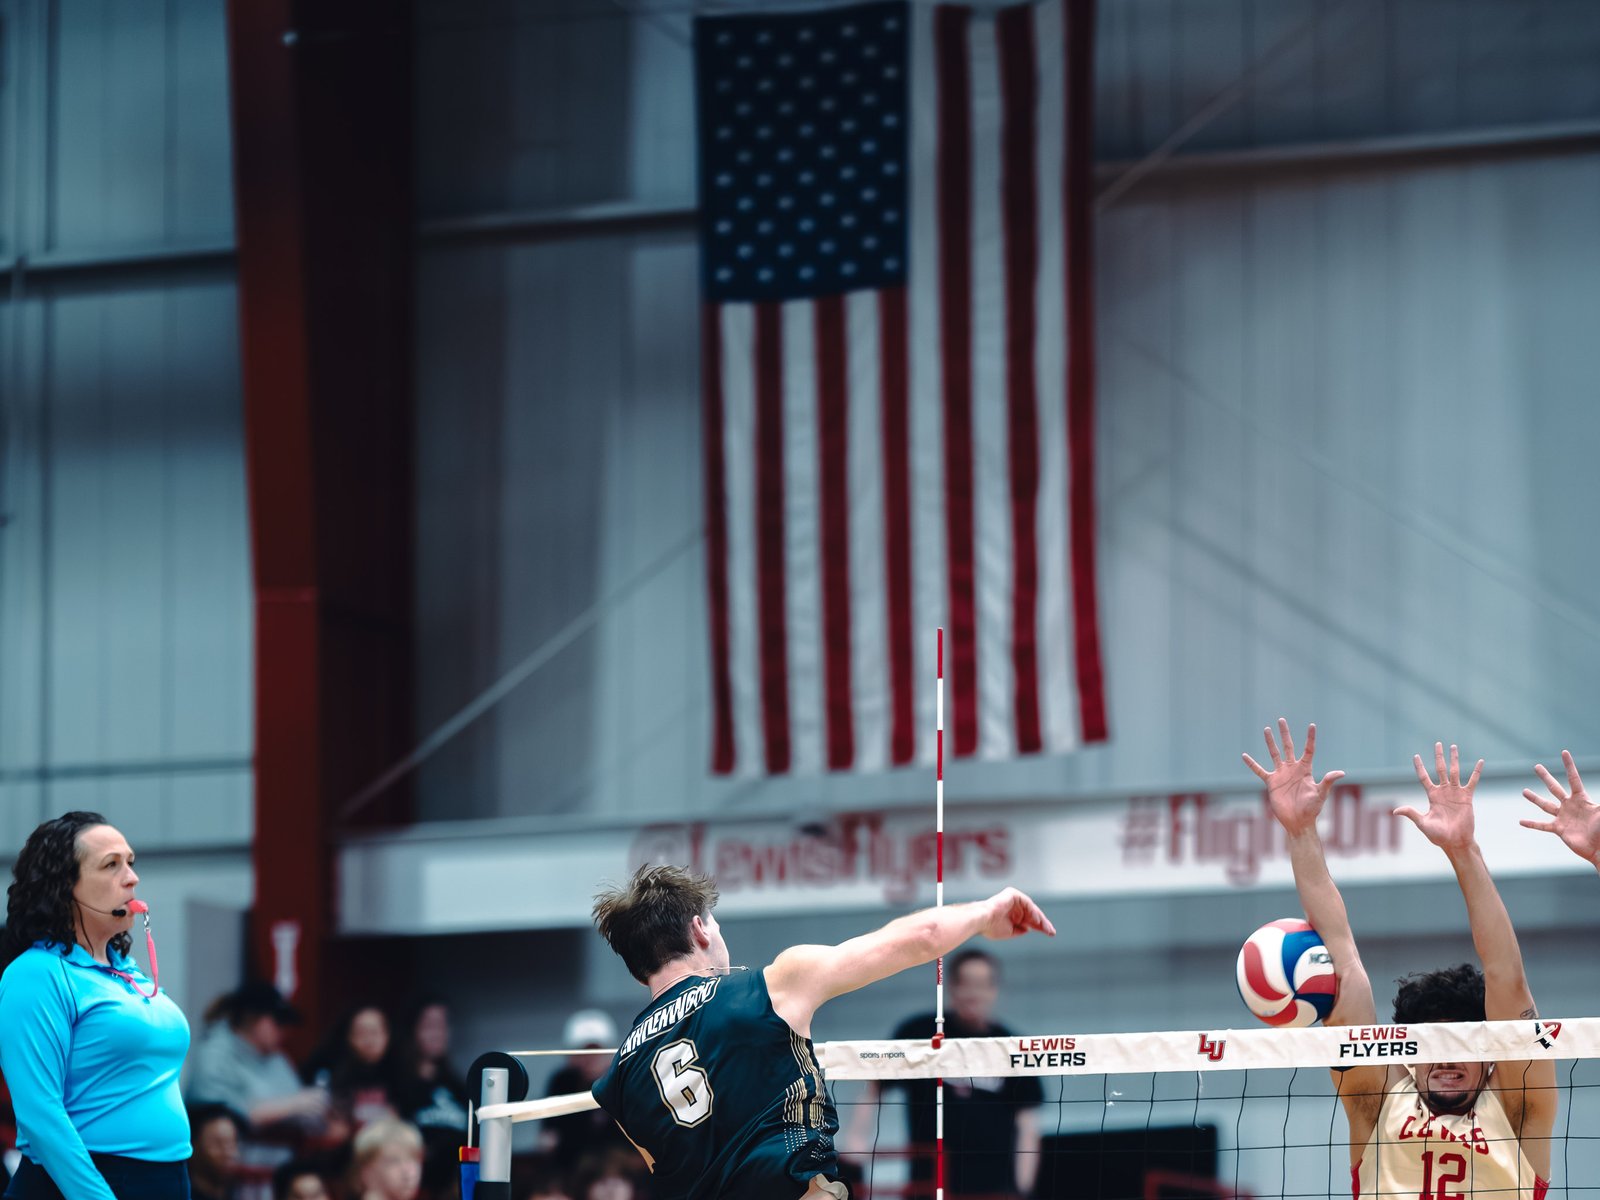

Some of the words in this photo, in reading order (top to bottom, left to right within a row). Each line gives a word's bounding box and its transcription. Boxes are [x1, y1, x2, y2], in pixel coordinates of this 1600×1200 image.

[1348, 1026, 1408, 1041] LEWIS
[1018, 1037, 1076, 1052] LEWIS
[1197, 1032, 1226, 1062] LU
[1339, 1041, 1418, 1058] FLYERS
[859, 1051, 880, 1060] sports
[1009, 1052, 1086, 1069] FLYERS
[650, 1038, 714, 1128] 6
